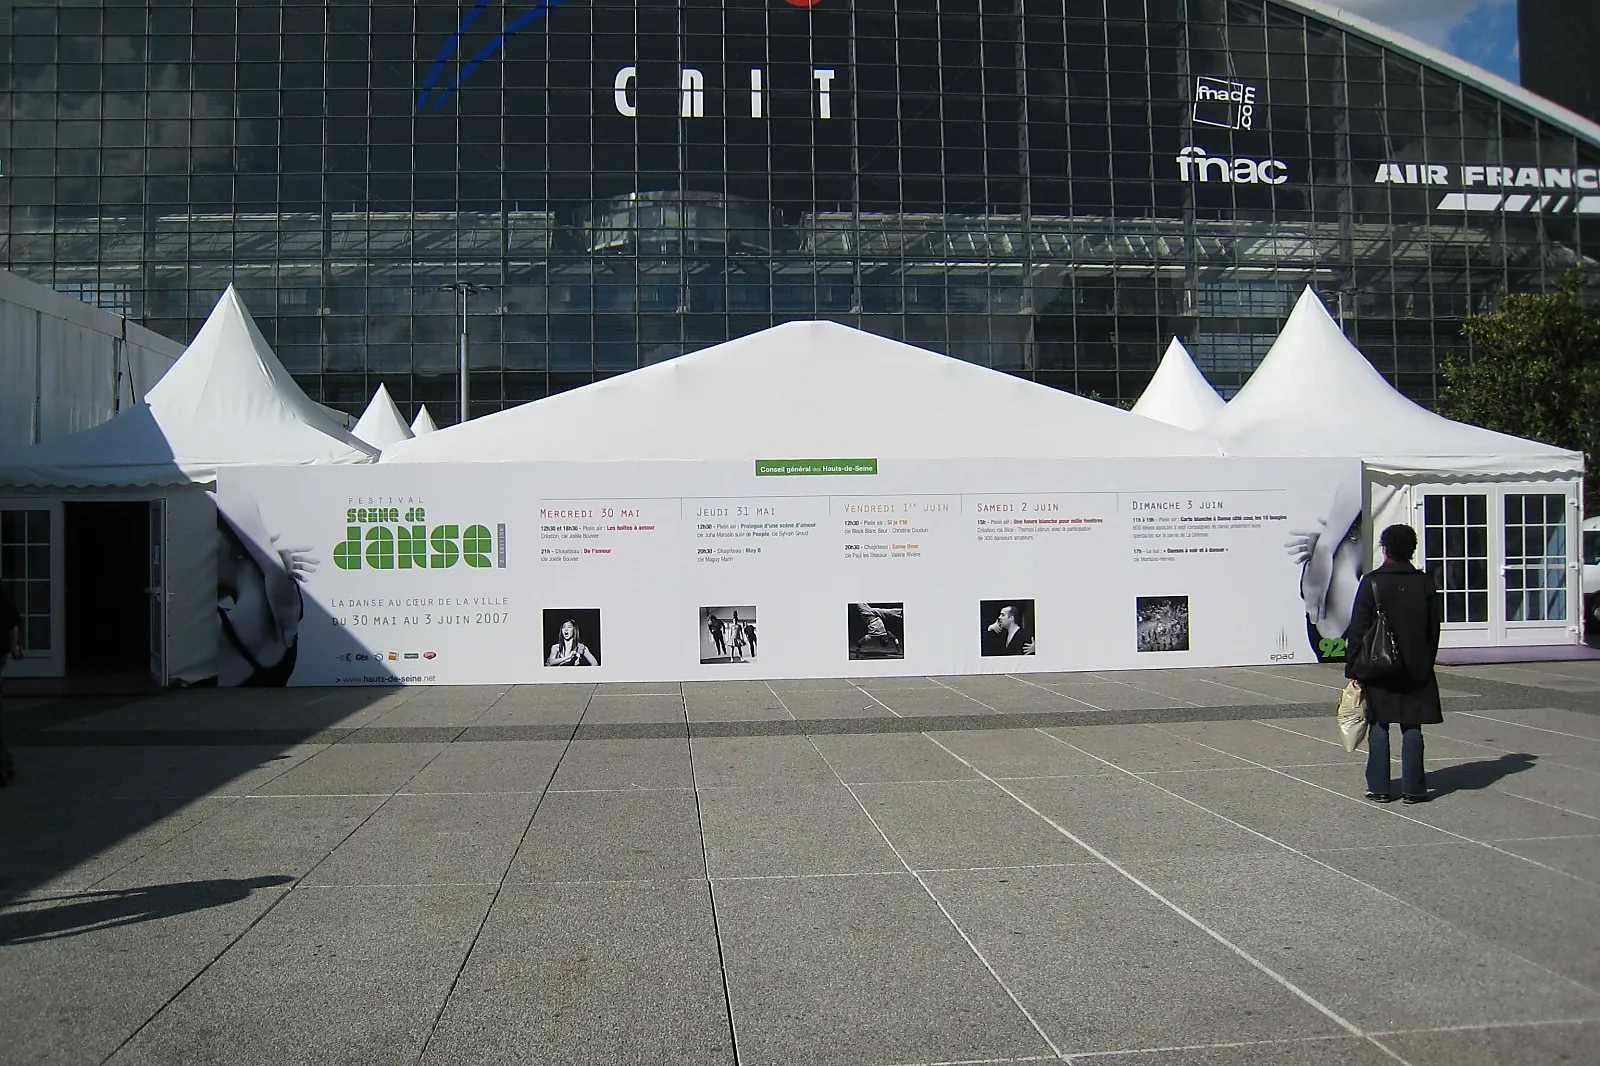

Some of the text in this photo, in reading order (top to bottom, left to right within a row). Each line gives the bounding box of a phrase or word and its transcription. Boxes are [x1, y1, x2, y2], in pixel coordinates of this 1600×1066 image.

[1198, 86, 1242, 101] fnac
[1176, 146, 1288, 185] fnac
[1374, 163, 1600, 189] AIR FRANC
[786, 465, 811, 474] général
[348, 496, 424, 505] FESTIVAL
[1132, 501, 1180, 510] DIMANCHE
[1187, 500, 1193, 510] 3
[696, 506, 776, 517] JEUDI 31 MAI
[844, 504, 895, 513] VENDREDI
[924, 504, 949, 512] JUIN
[977, 502, 1059, 512] SAMEDI 2 JUIN
[540, 508, 641, 518] MERCREDI 30 MAI
[332, 524, 493, 570] danse
[331, 597, 508, 608] LA DANSE AU CŒUR DE LA VILLE
[332, 612, 509, 627] DU 30 MAI AU 3 JUIN 2007
[1270, 652, 1295, 662] epad
